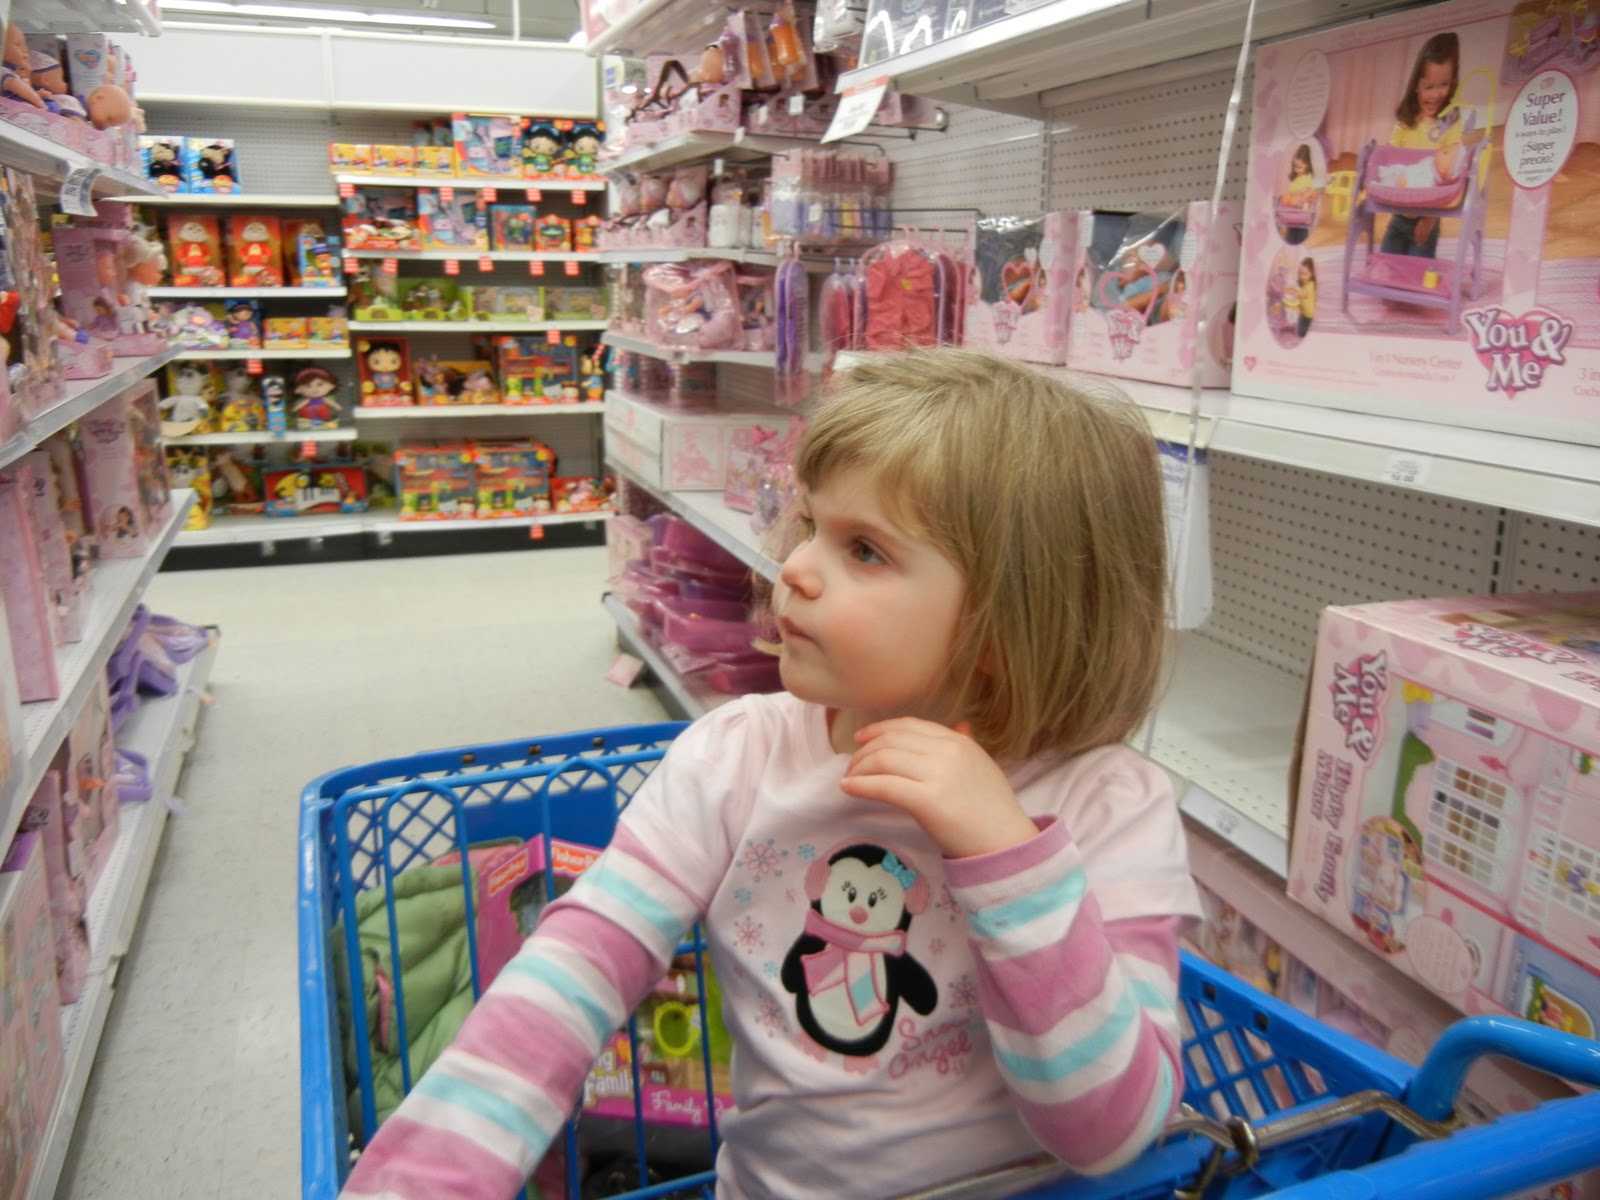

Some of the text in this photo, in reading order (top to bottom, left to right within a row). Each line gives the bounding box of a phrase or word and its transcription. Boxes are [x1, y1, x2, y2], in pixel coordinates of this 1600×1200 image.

[1522, 108, 1563, 126] Value!
[1526, 92, 1566, 110] Super
[1465, 308, 1573, 366] You &
[1486, 352, 1543, 392] Me
[1332, 663, 1359, 724] Me
[1345, 650, 1388, 761] You &
[583, 1067, 634, 1106] Famil
[651, 1090, 703, 1126] Family
